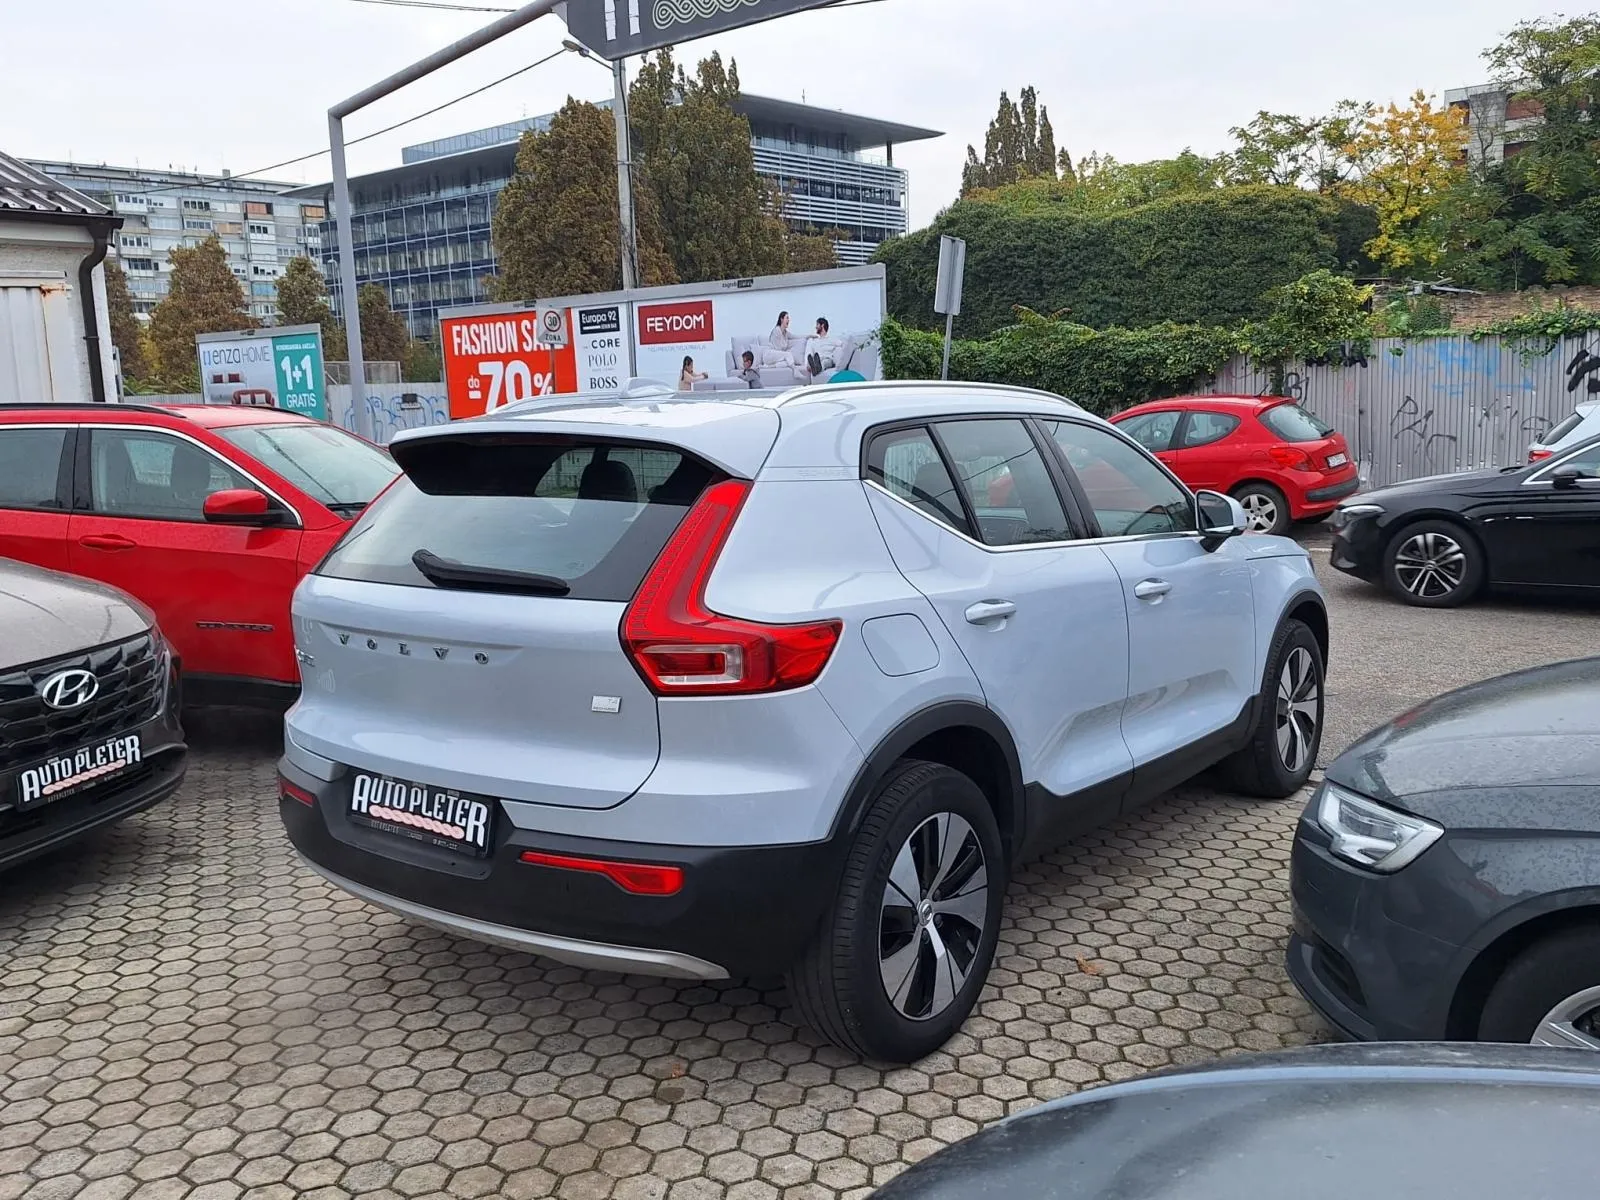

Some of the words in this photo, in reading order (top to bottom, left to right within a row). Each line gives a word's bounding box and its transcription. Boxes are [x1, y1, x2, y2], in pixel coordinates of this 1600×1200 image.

[547, 316, 558, 327] 30
[581, 312, 607, 324] Europa
[607, 310, 617, 321] 92
[646, 314, 705, 333] FEYDOM
[451, 320, 519, 356] FASHION
[545, 333, 562, 342] ZONA
[591, 337, 621, 349] CORE
[242, 345, 271, 363] HOME
[588, 352, 617, 368] POLO
[281, 354, 314, 391] 1+1
[468, 375, 480, 389] do
[590, 375, 618, 389] BOSS
[286, 393, 317, 408] GRATIS
[338, 633, 489, 665] VOLVO
[21, 757, 72, 802] AUTO
[74, 735, 141, 774] PLETER
[351, 774, 407, 814] AUTO
[409, 787, 488, 847] PLETER
